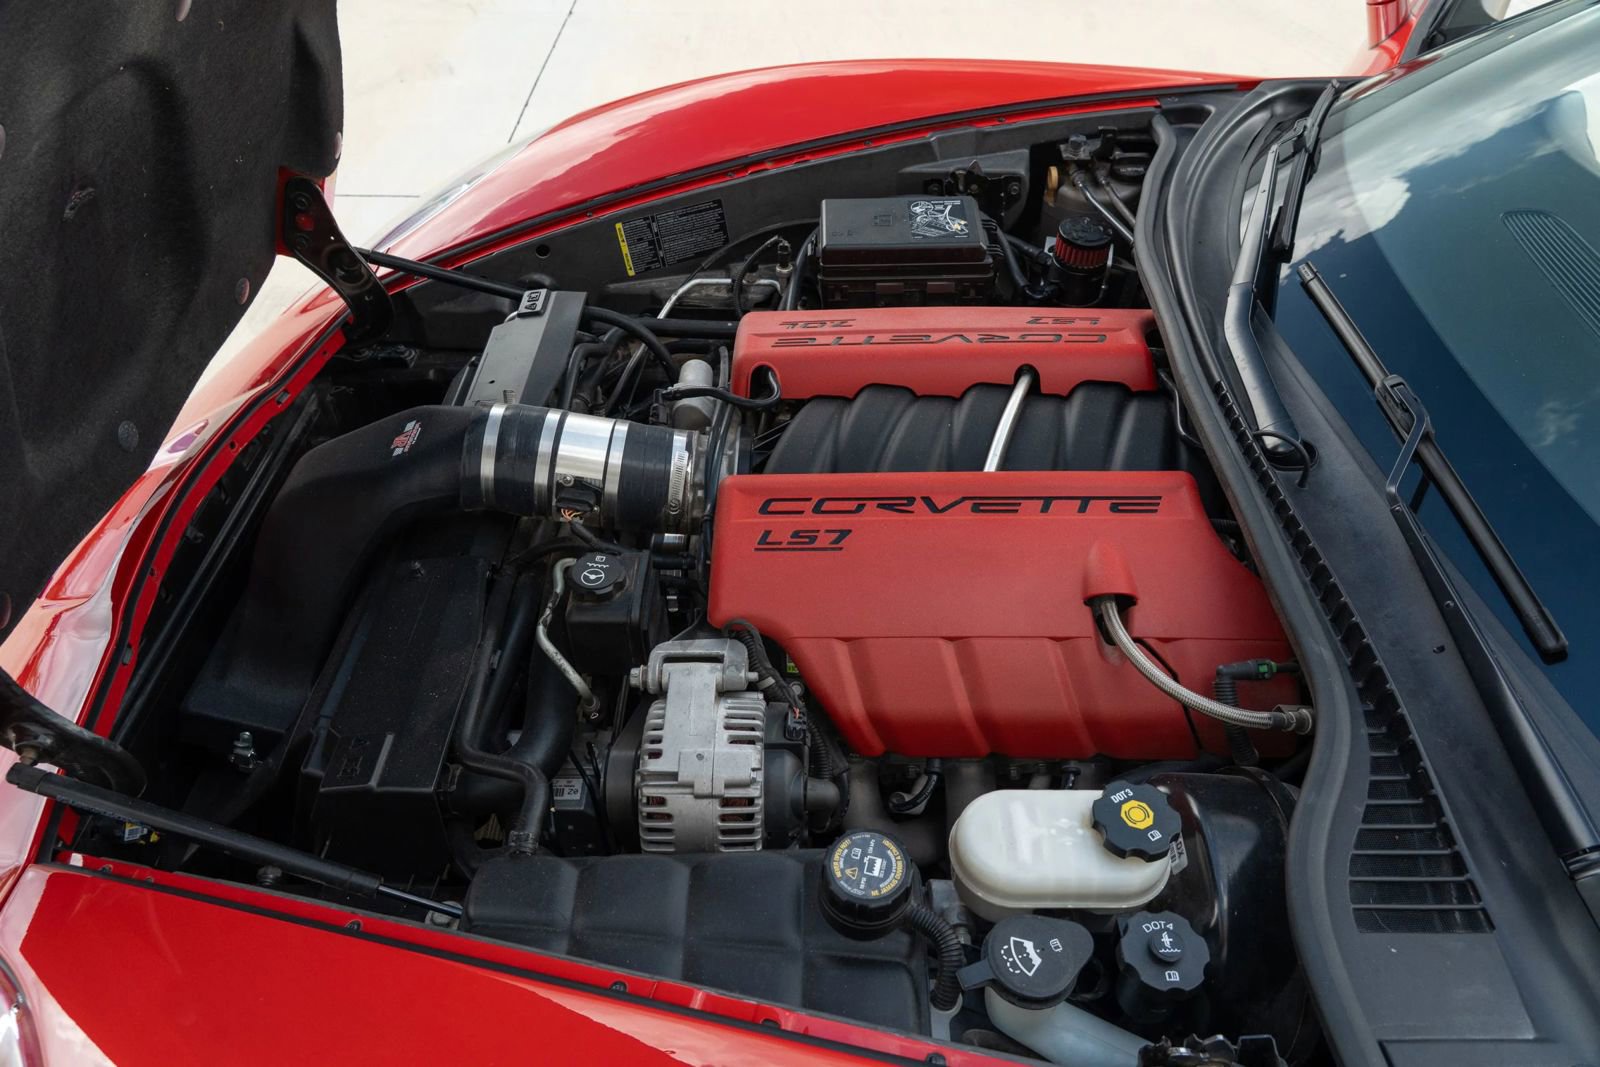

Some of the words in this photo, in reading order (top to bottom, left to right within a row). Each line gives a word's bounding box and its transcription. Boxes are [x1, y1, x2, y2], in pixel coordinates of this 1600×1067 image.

[1026, 316, 1101, 325] LS7
[771, 333, 1107, 347] CORVETTE
[758, 496, 1162, 515] CORVETTE
[756, 529, 852, 547] LS7
[1110, 791, 1127, 803] DOT
[1142, 920, 1174, 933] DOT4
